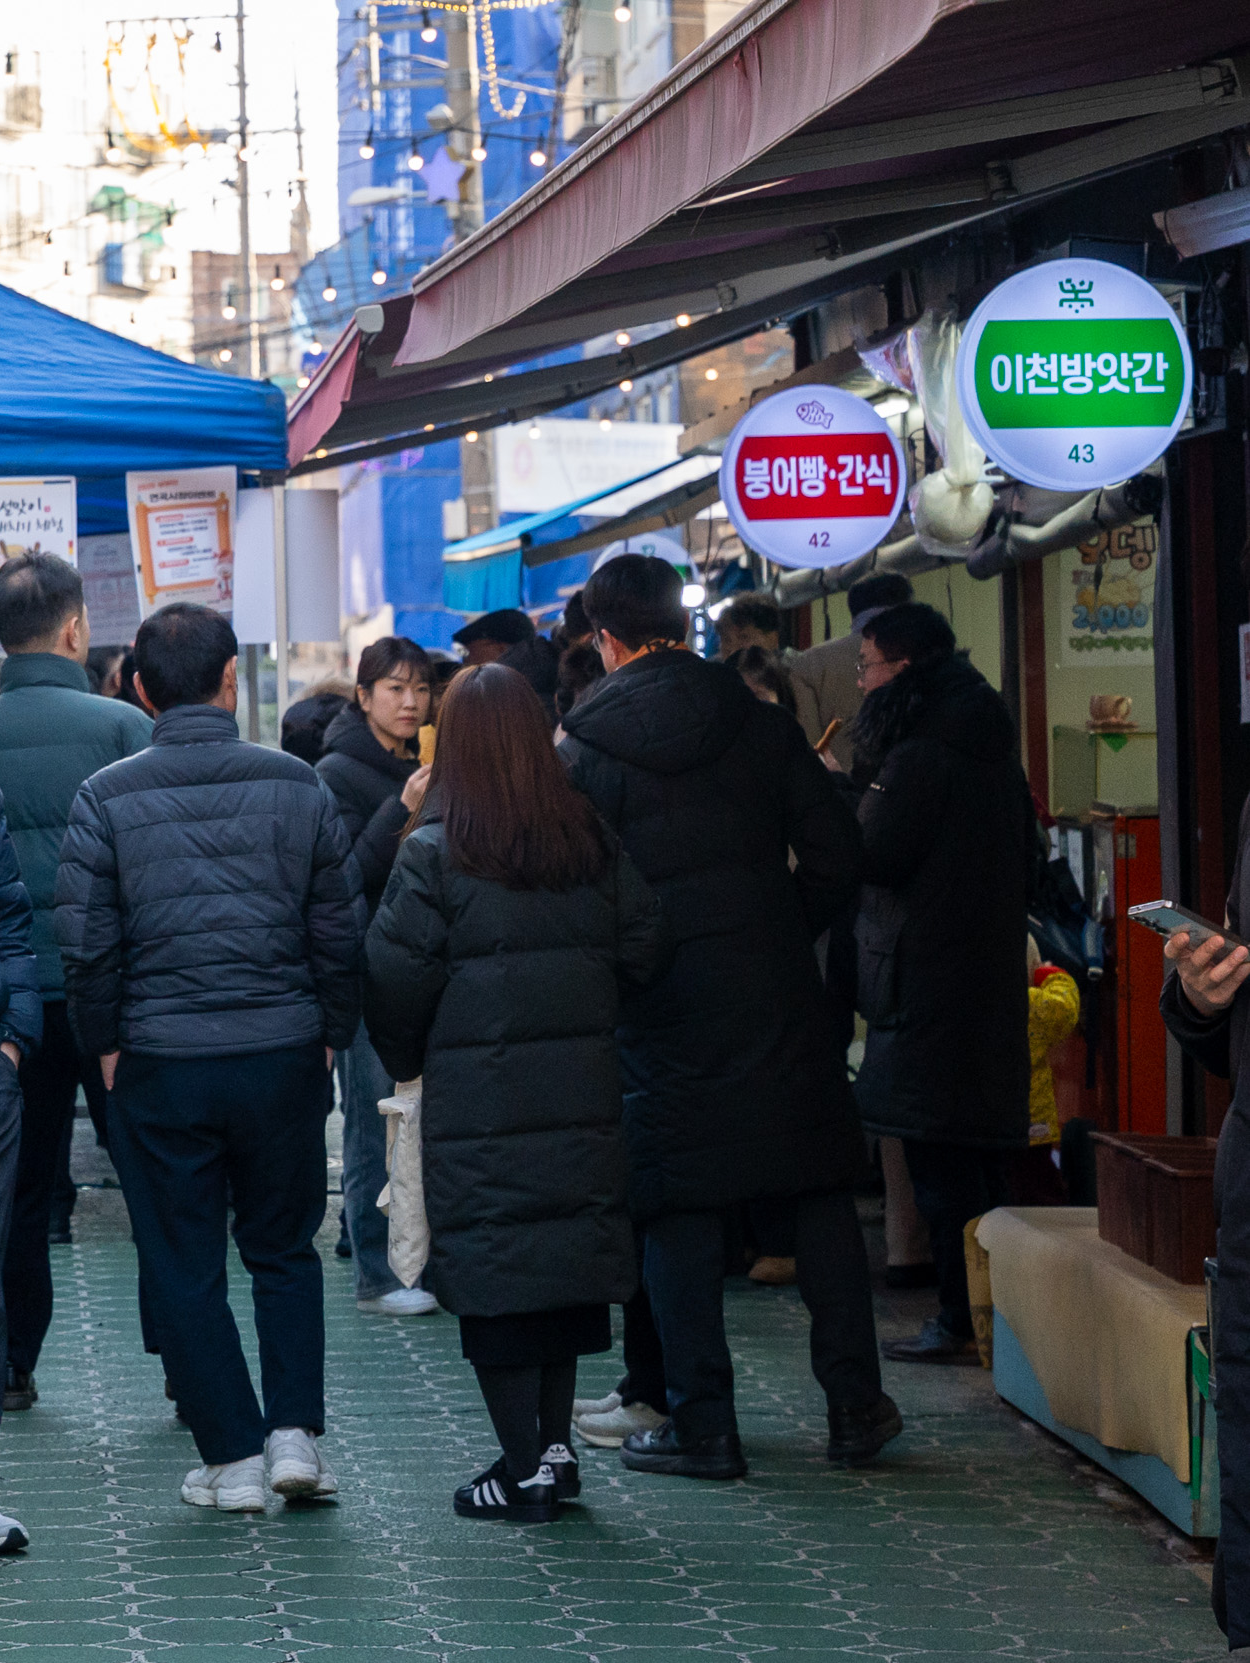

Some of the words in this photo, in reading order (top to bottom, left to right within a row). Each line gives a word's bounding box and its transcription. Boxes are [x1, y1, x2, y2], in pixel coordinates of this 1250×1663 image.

[990, 352, 1169, 395] 이천방앗간
[1068, 444, 1095, 464] 43
[808, 532, 831, 548] 42
[1072, 603, 1149, 632] 2,000
